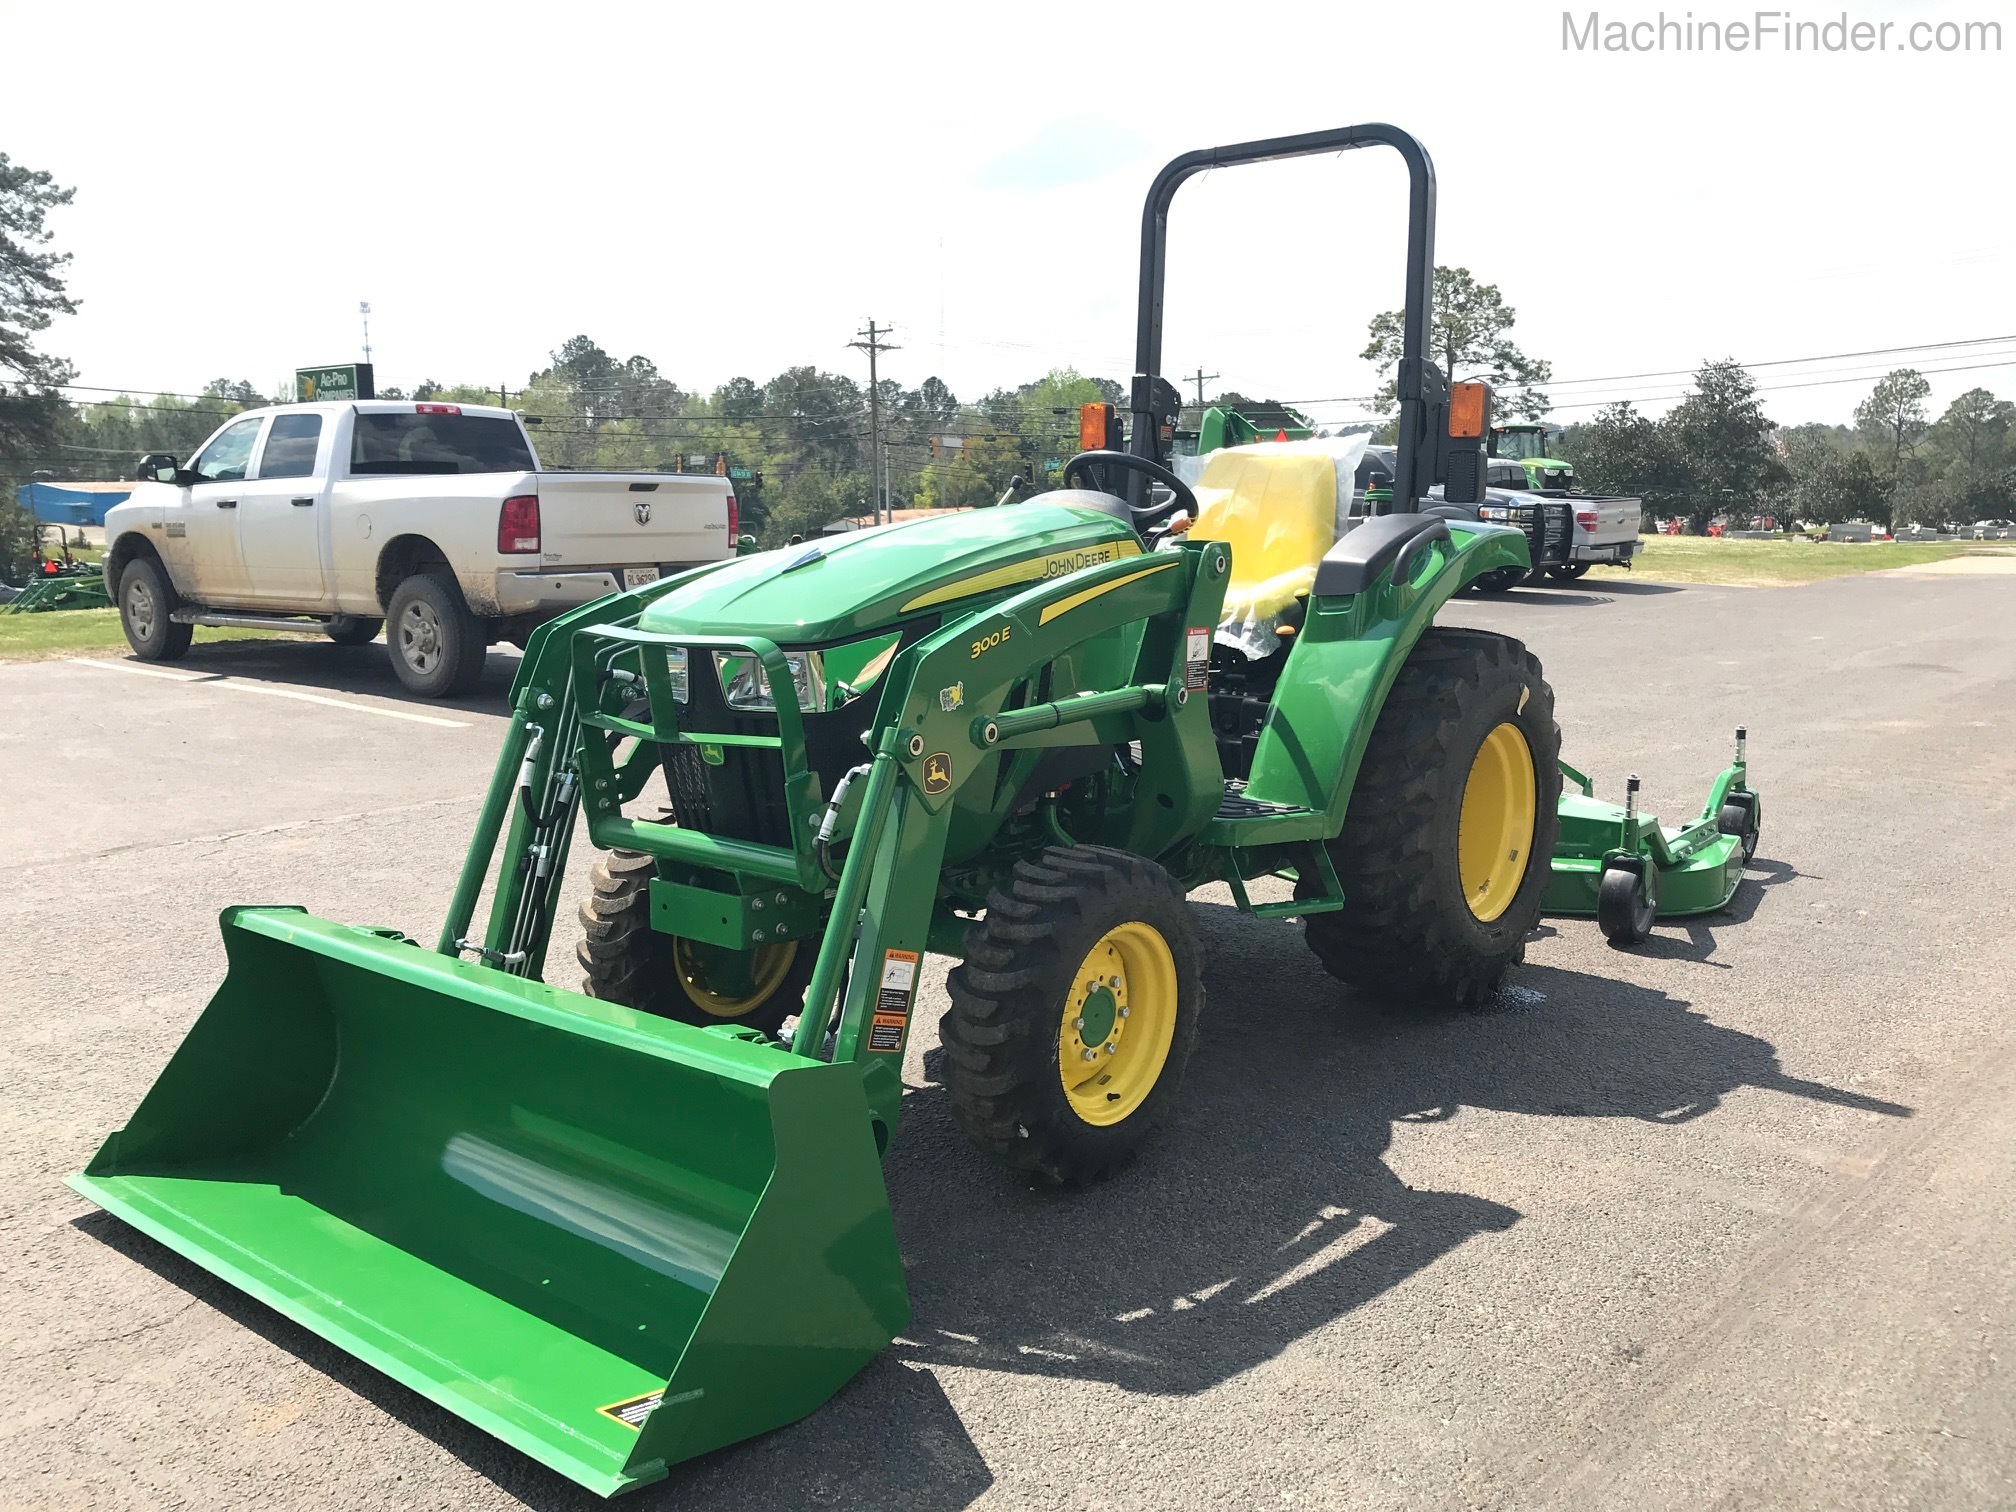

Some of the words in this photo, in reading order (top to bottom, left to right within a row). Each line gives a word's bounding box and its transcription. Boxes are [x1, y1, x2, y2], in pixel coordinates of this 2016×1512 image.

[1043, 558, 1075, 577] JOHN
[1075, 550, 1111, 570] DEERE
[970, 632, 1001, 660] 300
[894, 952, 915, 961] WARNING
